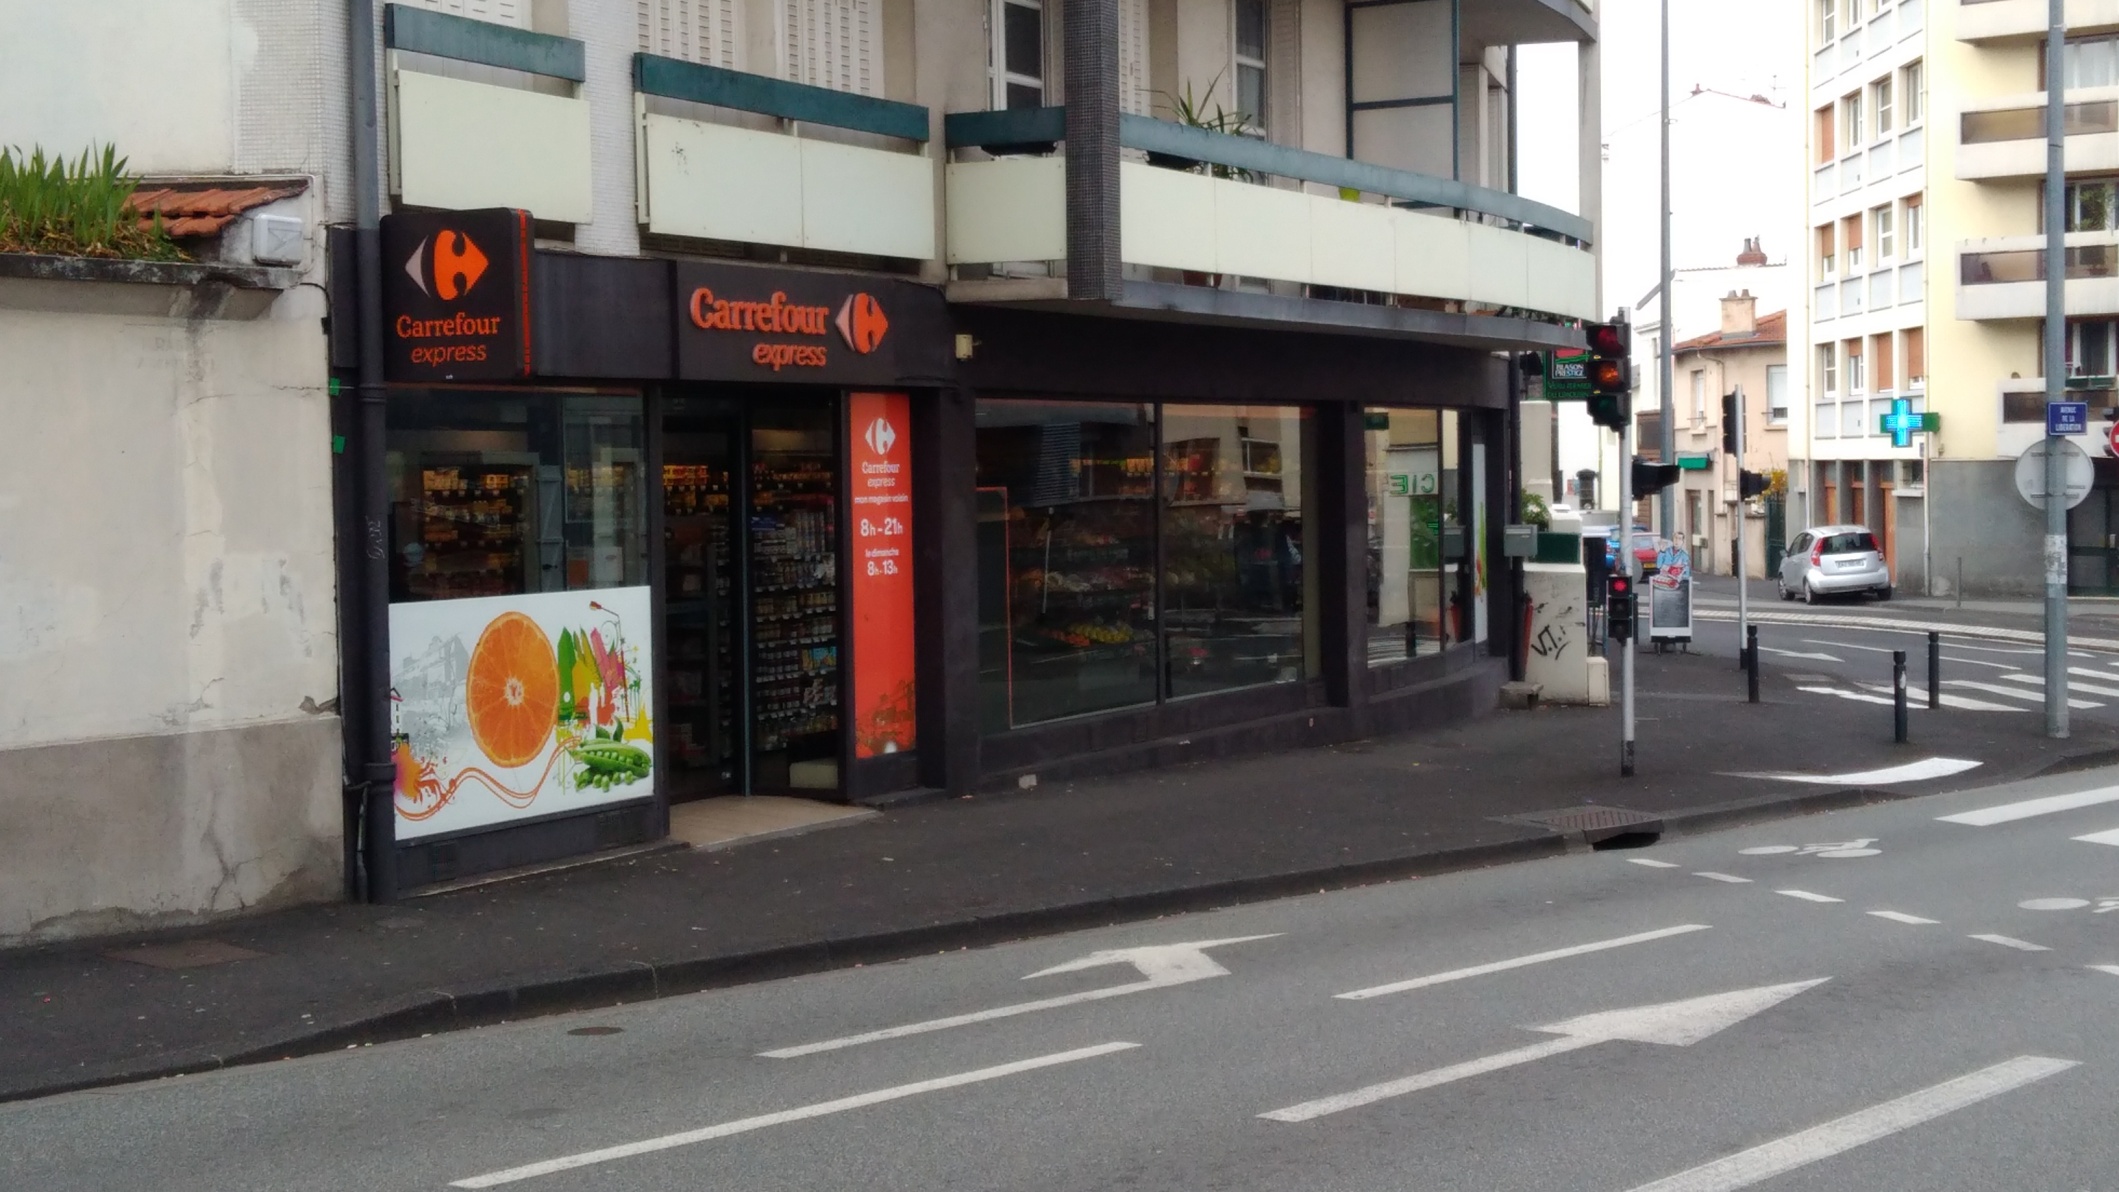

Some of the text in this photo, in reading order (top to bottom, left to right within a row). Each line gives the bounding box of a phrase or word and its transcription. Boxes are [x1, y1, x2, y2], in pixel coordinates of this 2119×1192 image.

[690, 287, 829, 335] Carrefour
[396, 311, 501, 339] Carrefour
[411, 344, 487, 368] express
[752, 343, 828, 371] express
[862, 460, 900, 474] Carrefour
[867, 478, 896, 488] express
